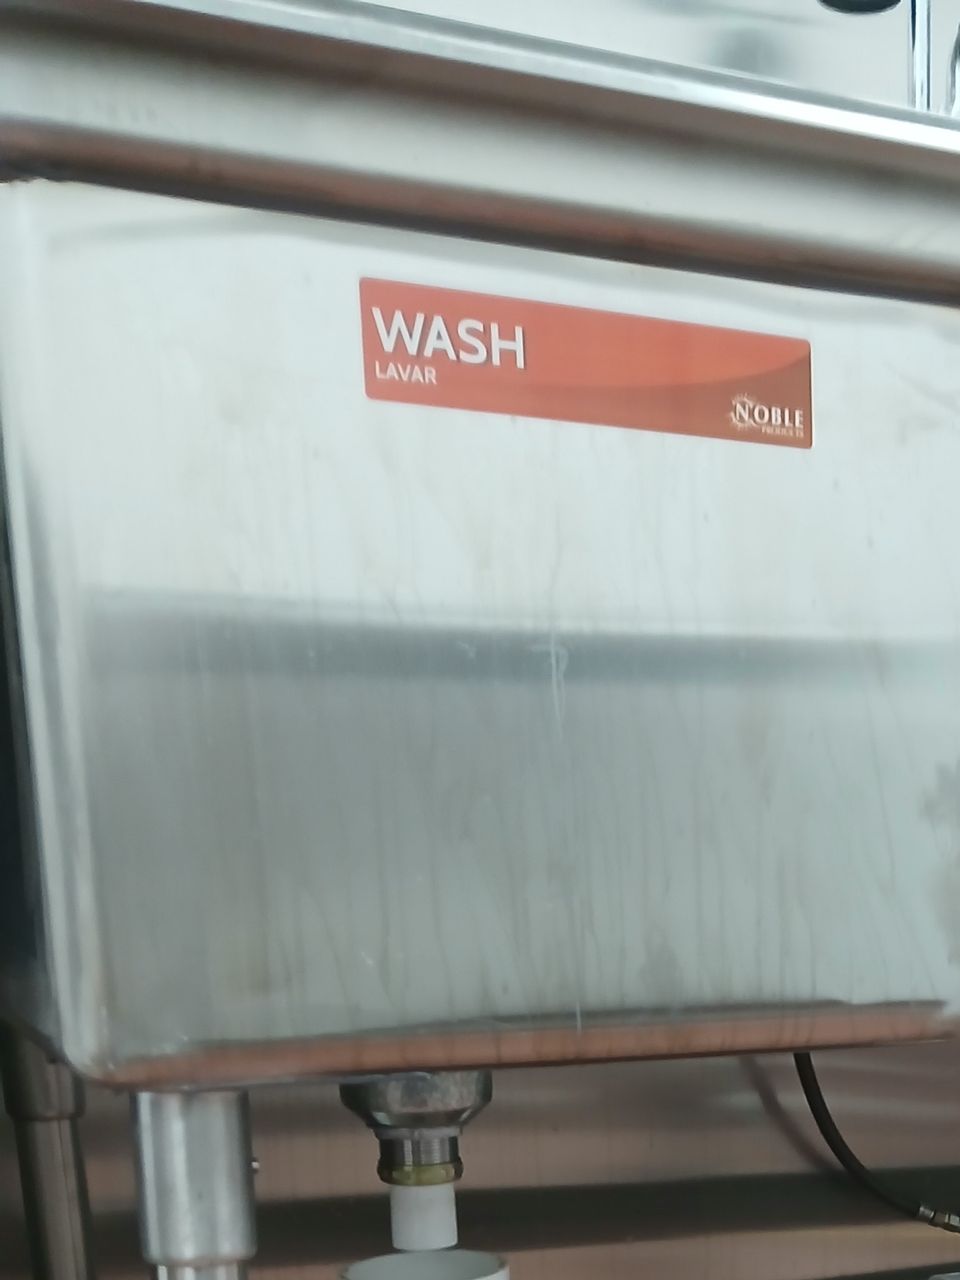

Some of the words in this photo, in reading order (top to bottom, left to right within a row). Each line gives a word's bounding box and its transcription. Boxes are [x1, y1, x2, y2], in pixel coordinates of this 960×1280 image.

[371, 306, 525, 369] WASH
[375, 360, 437, 385] LAVAR
[735, 402, 804, 429] NOBLE
